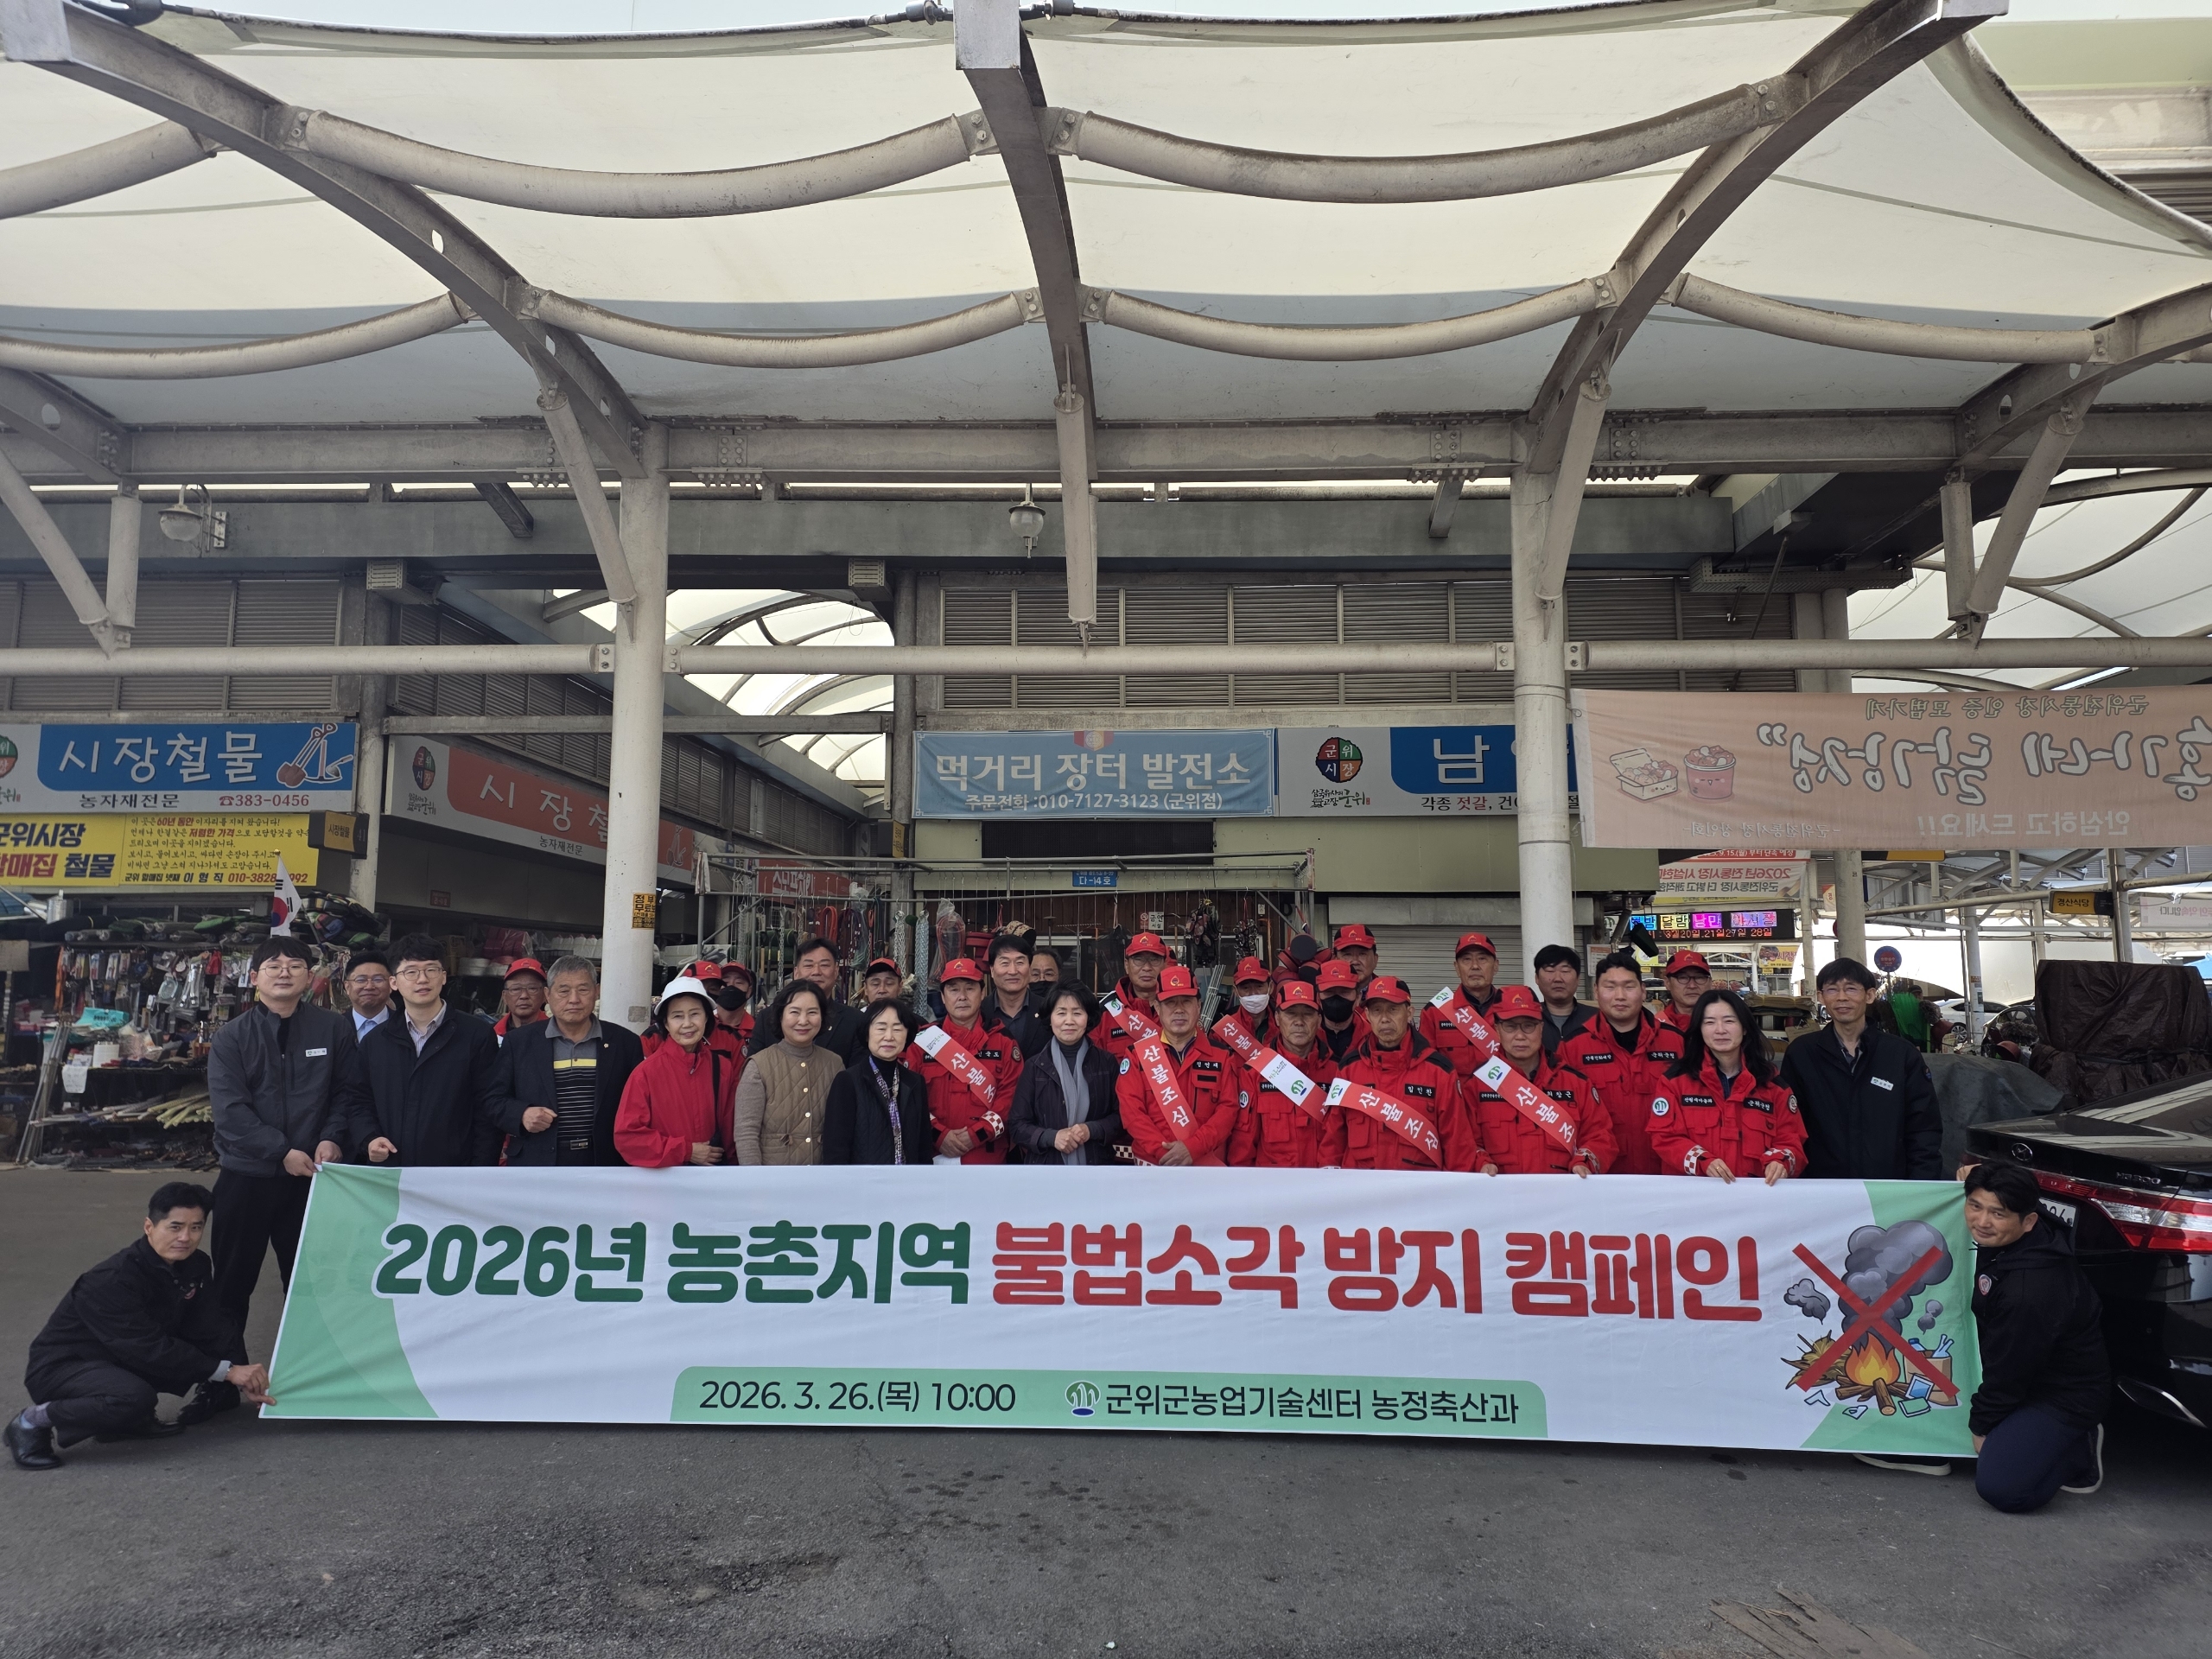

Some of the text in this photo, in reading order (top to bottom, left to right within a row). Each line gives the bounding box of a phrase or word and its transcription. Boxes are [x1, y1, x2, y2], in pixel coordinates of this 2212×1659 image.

[59, 729, 263, 784] 시장철물
[1325, 744, 1354, 758] 군위
[1433, 734, 1495, 785] 남
[936, 753, 1251, 791] 먹거리 장터 발전소
[1325, 762, 1355, 777] 시장
[79, 793, 309, 809] 농자재전문 383-0456
[965, 794, 1029, 812] 주문전화
[1163, 792, 1223, 810] (군위점)
[1421, 796, 1451, 811] 각종
[1457, 796, 1492, 812] 젓갈,
[539, 836, 583, 856] 농자재전문
[64, 853, 116, 878] 철물
[2057, 898, 2090, 907] 경산식당
[1662, 916, 1688, 929] 달밤
[1694, 914, 1721, 928] 낭만
[1359, 1091, 1439, 1151] 산불조심
[376, 1220, 1762, 1322] 2026년 농촌지역 불법소각 방지 캠페인
[700, 1380, 1519, 1425] 2026. 3. 26.(목) 10:00 군위군농업기술센터 농정축산과
